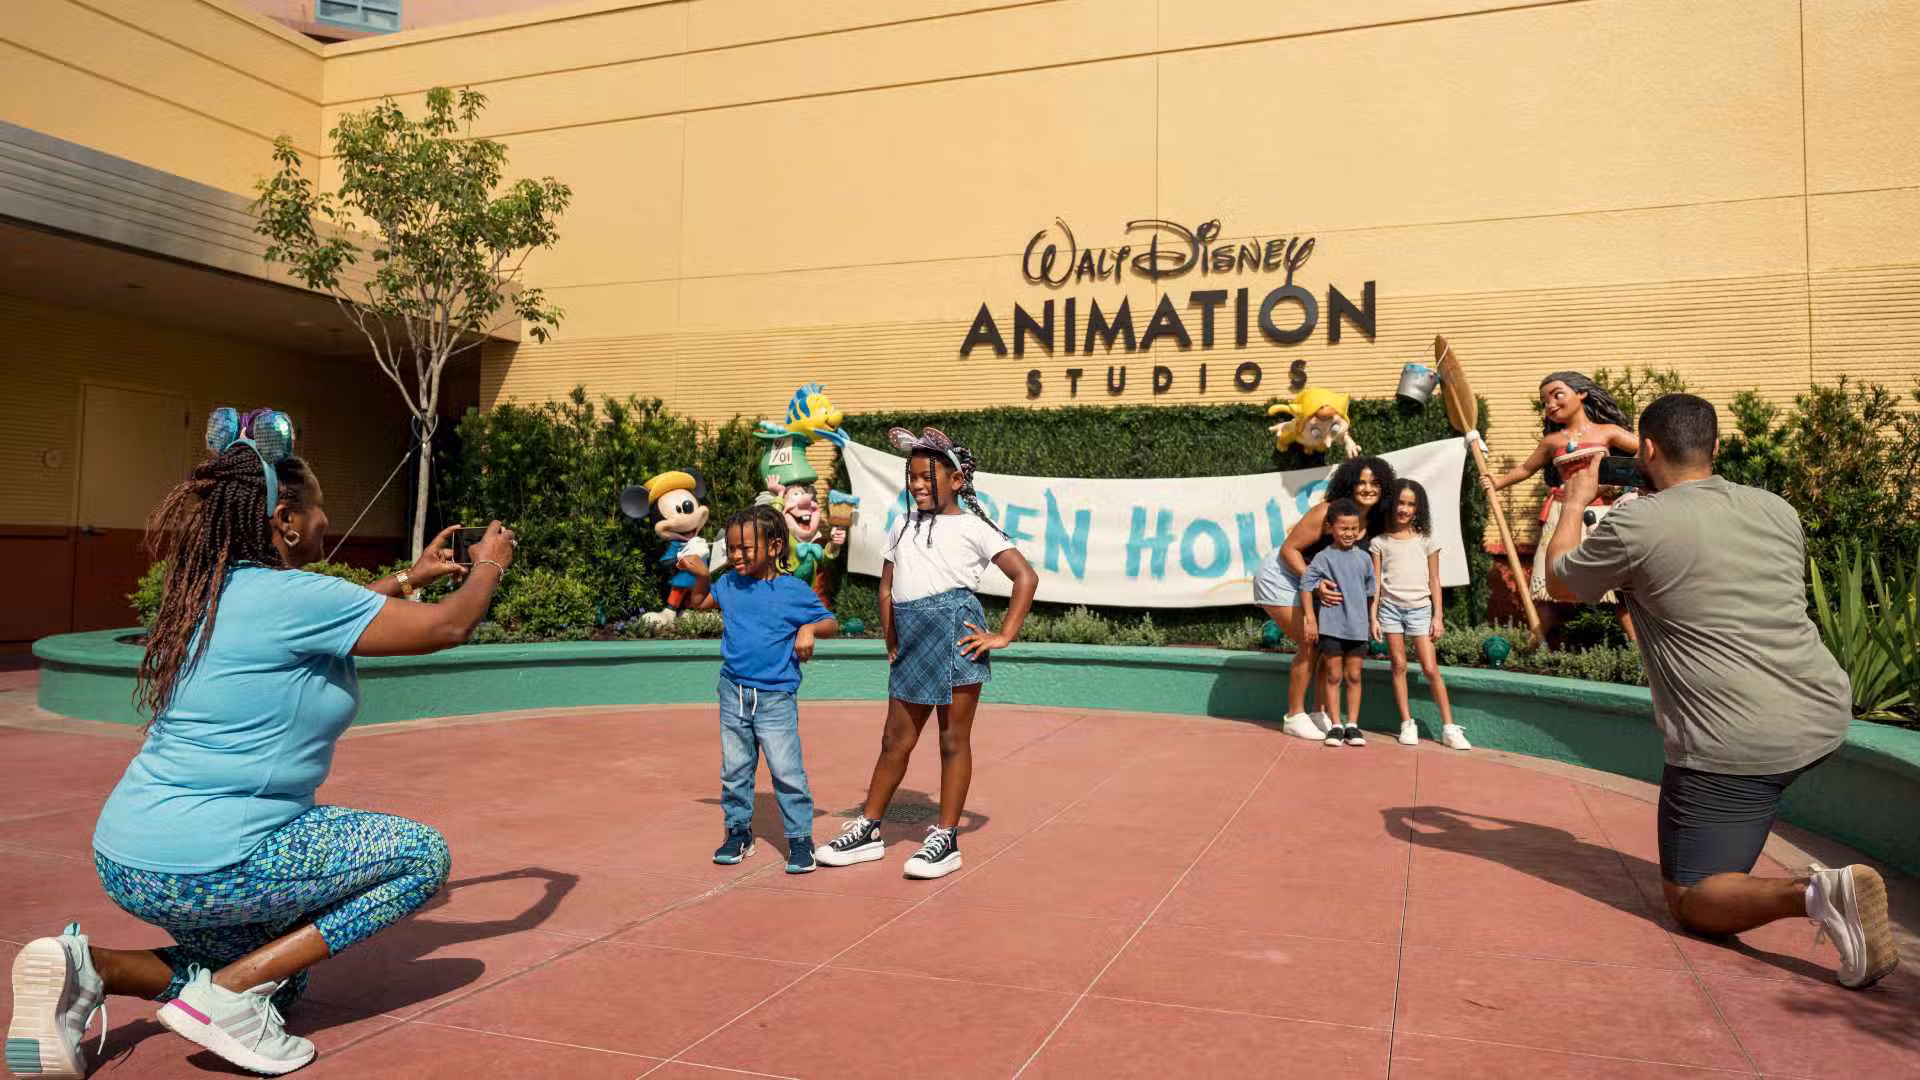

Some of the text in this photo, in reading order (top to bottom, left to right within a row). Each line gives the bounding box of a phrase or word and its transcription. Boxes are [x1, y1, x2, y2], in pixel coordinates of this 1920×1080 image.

[959, 280, 1377, 359] ANIMATION
[1026, 359, 1308, 399] STUDIOS
[884, 479, 1329, 583] EN HOU
